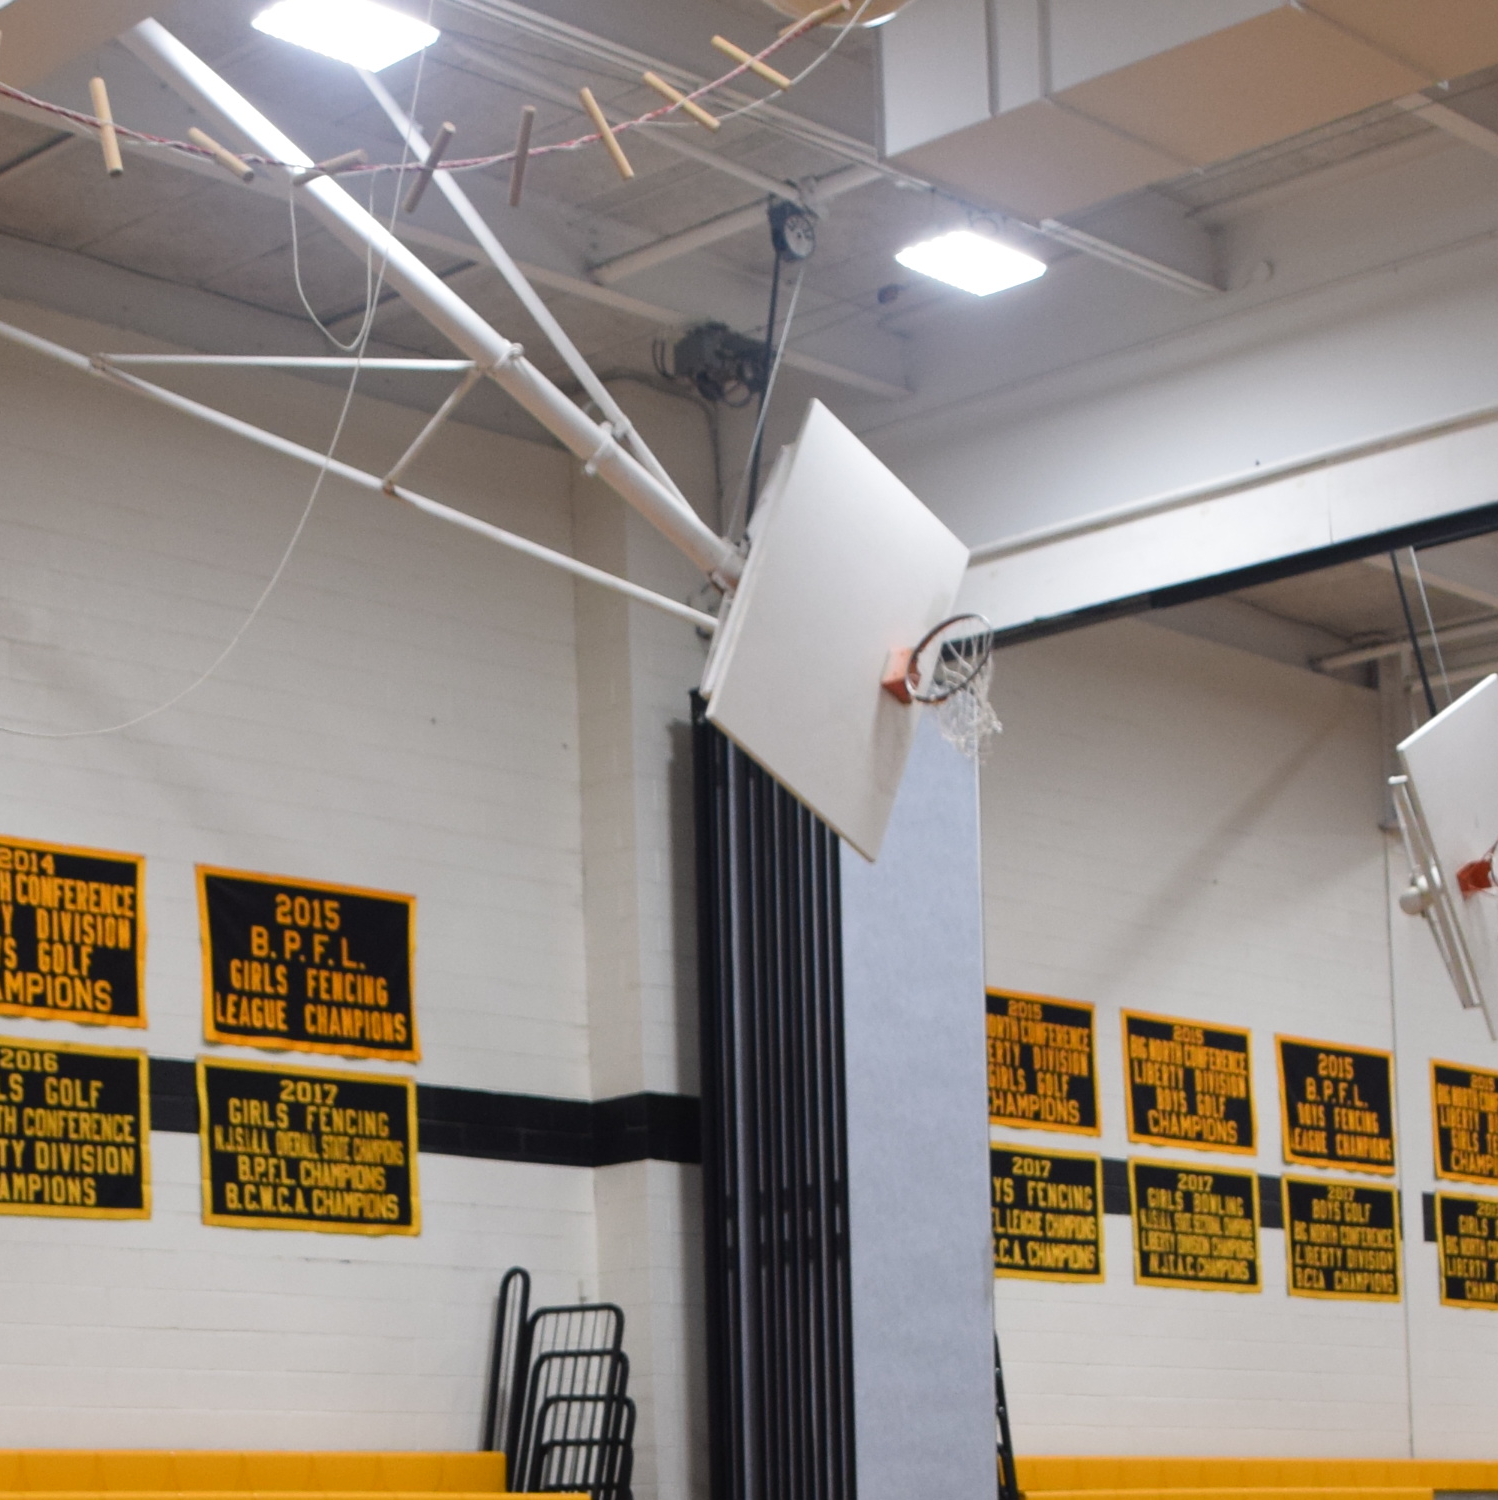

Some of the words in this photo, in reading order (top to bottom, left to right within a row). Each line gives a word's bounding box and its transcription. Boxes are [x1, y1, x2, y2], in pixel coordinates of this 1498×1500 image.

[15, 872, 134, 917] CONFERENCE
[36, 908, 130, 949] DIVISION
[275, 894, 340, 931] 2015
[38, 942, 94, 977] GOLF
[230, 959, 288, 995] GIRLS
[306, 968, 388, 1007] FENCING
[216, 992, 288, 1031] LEAGUE
[304, 1004, 406, 1043] CHAMPIONS
[0, 1049, 58, 1072] 2016
[45, 1077, 103, 1108] GOLF
[280, 1080, 338, 1105] 2017
[23, 1108, 135, 1143] CONFERENCE
[229, 1098, 289, 1128] GIRLS
[306, 1105, 389, 1137] FENCING
[1148, 1109, 1237, 1143] CHAMPIONS
[35, 1141, 134, 1175] DIVISION
[1012, 1156, 1051, 1178] 2017
[300, 1160, 385, 1191] CHAMPIONS
[312, 1189, 399, 1219] CHAMPIONS
